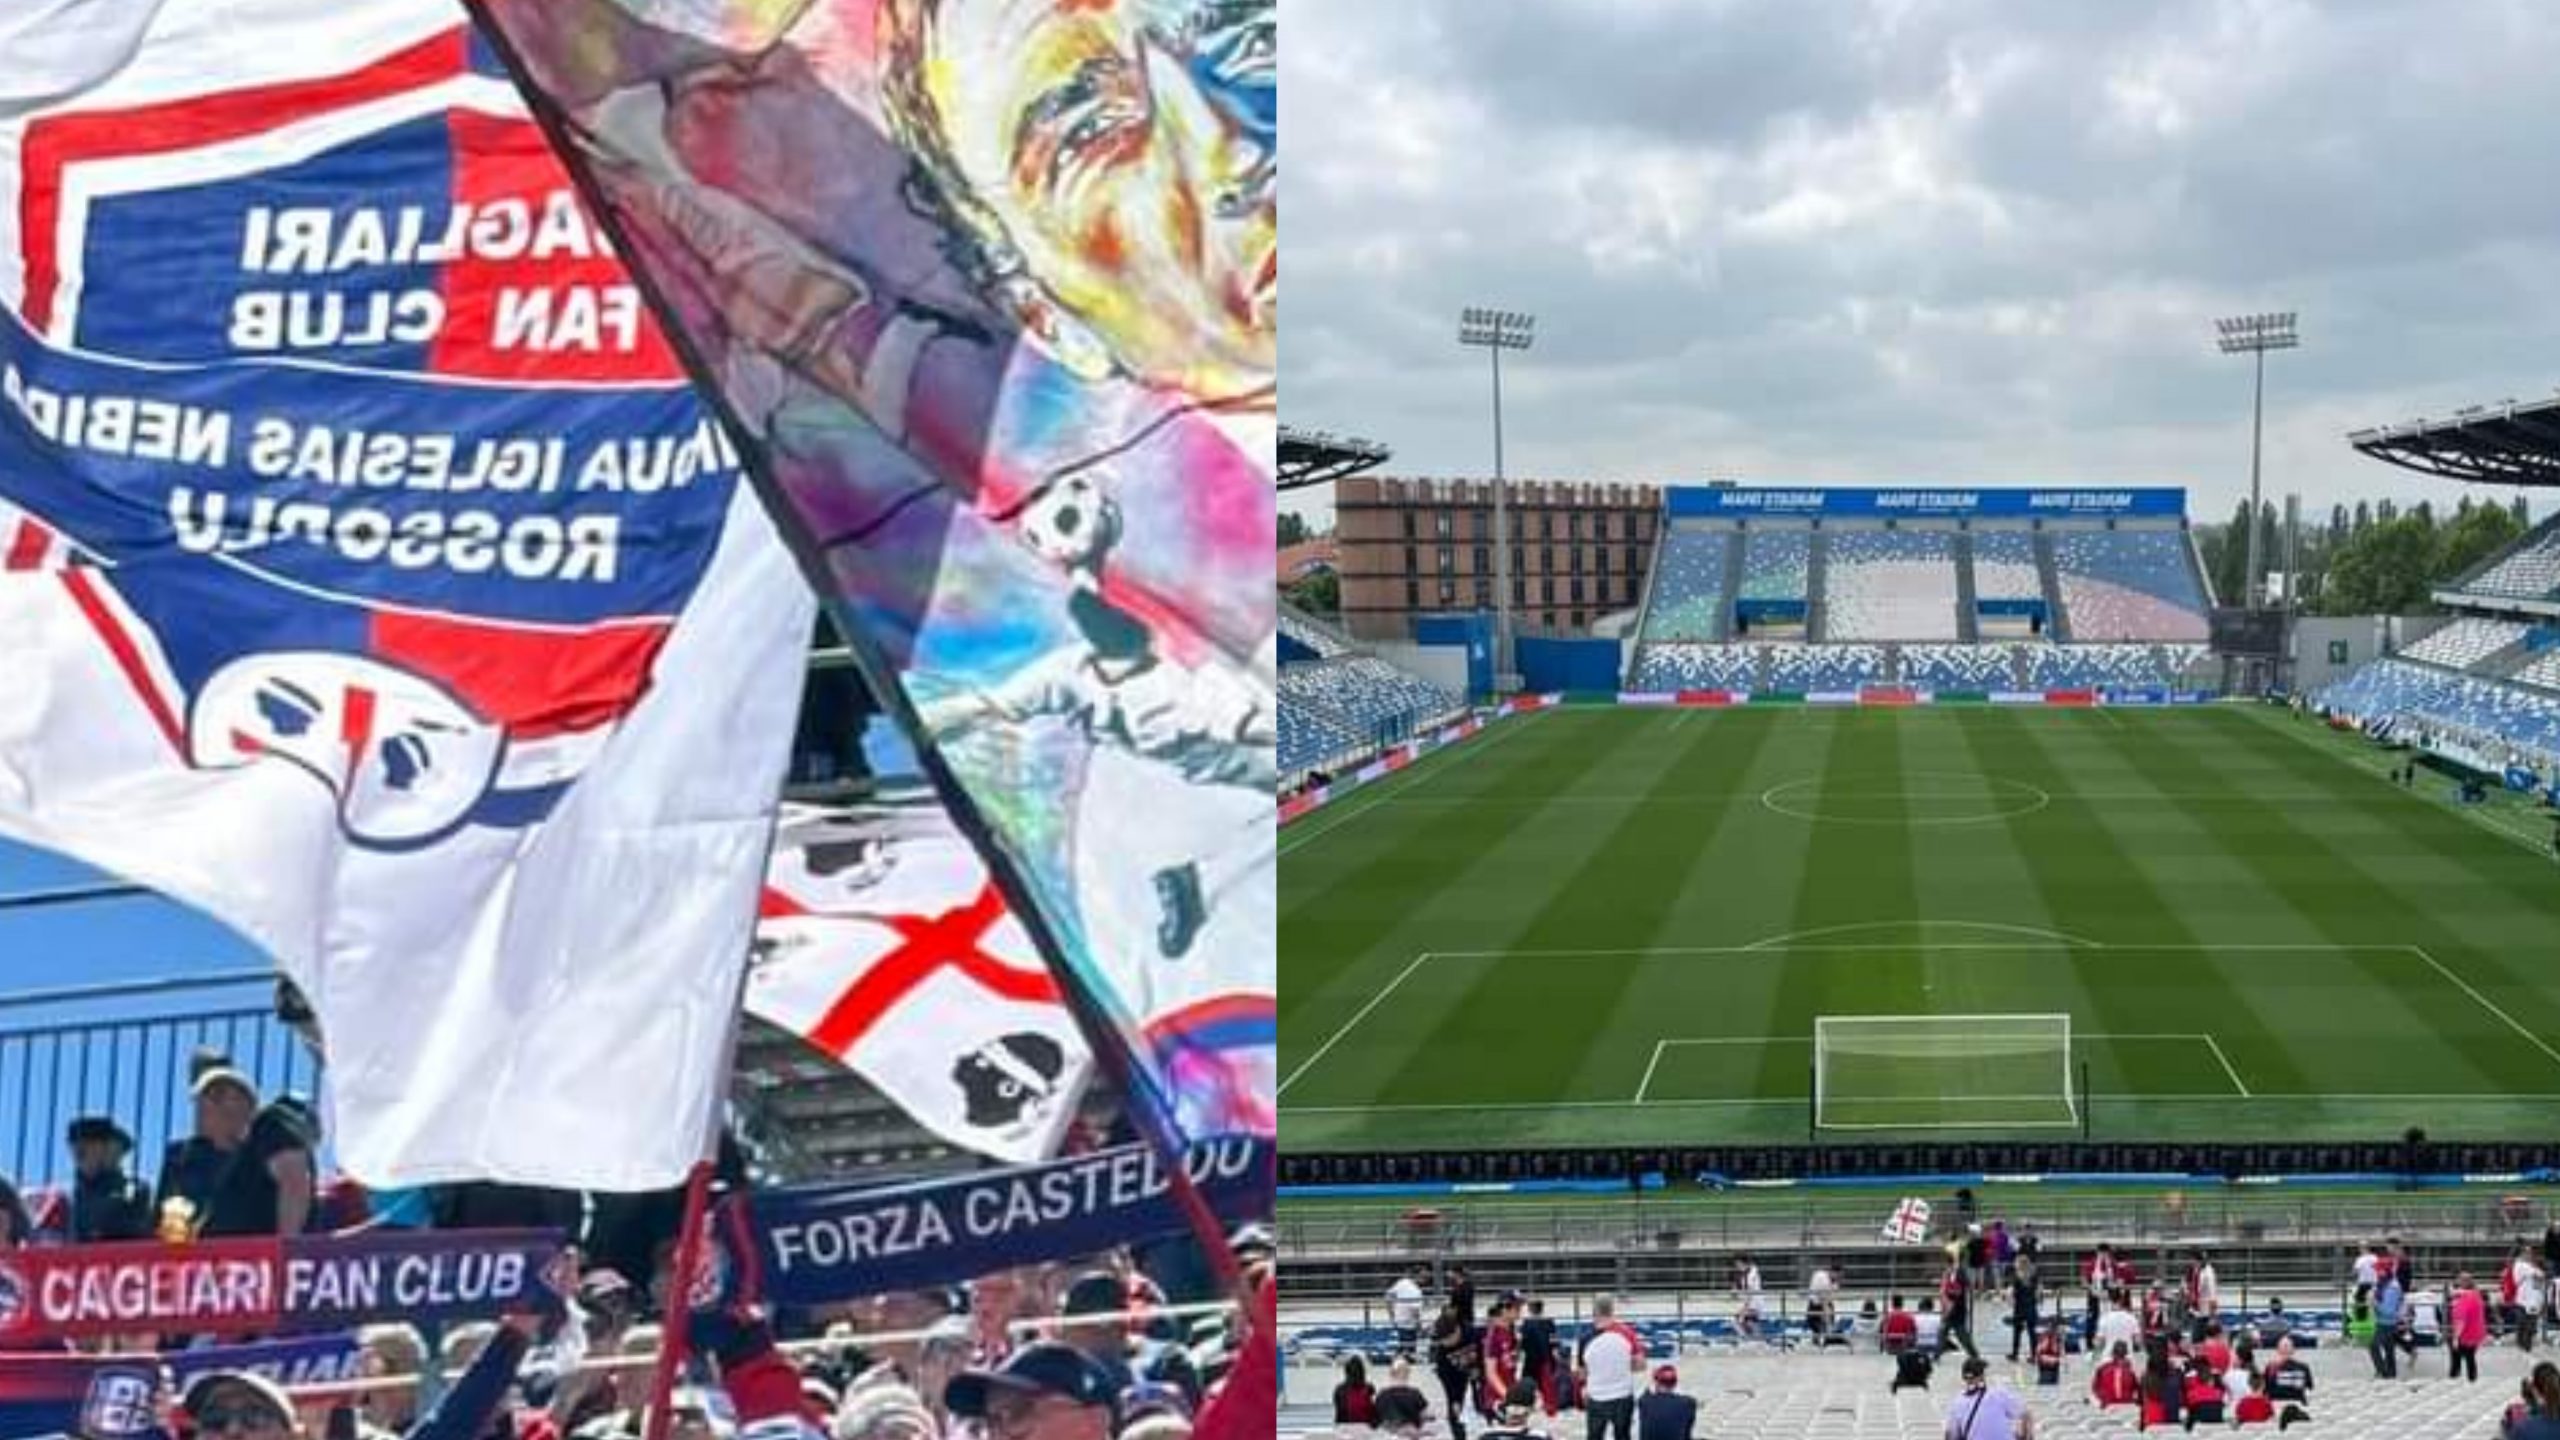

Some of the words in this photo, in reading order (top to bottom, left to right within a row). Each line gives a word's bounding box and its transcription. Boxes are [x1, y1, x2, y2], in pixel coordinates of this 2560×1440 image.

[771, 1202, 952, 1273] FORZA
[40, 1259, 273, 1321] CAGLIARI
[284, 1256, 381, 1311] FAN
[394, 1252, 526, 1306] CLUB
